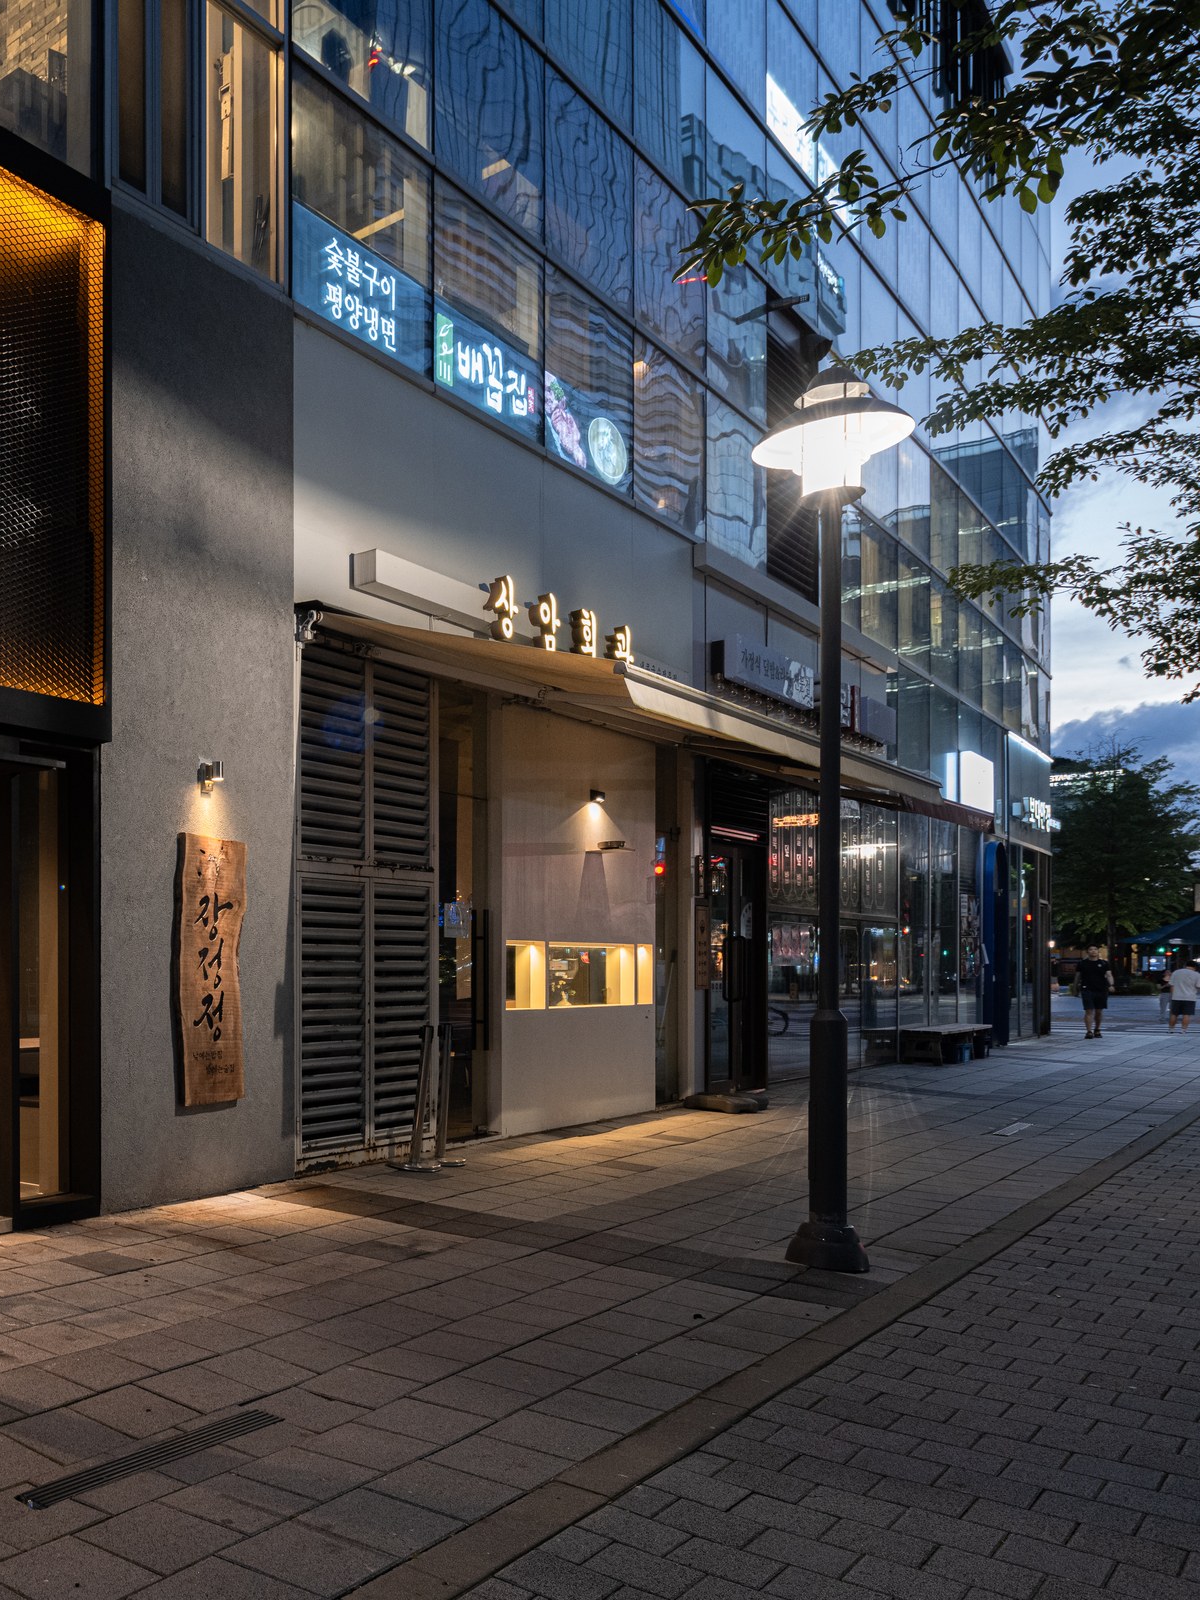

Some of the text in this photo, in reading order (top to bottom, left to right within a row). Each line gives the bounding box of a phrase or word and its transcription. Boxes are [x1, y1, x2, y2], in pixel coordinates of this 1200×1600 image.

[324, 236, 396, 312] 숯불구이
[324, 282, 397, 353] 평양냉면
[457, 341, 528, 416] 배꼽집
[193, 891, 234, 1043] 장정정
